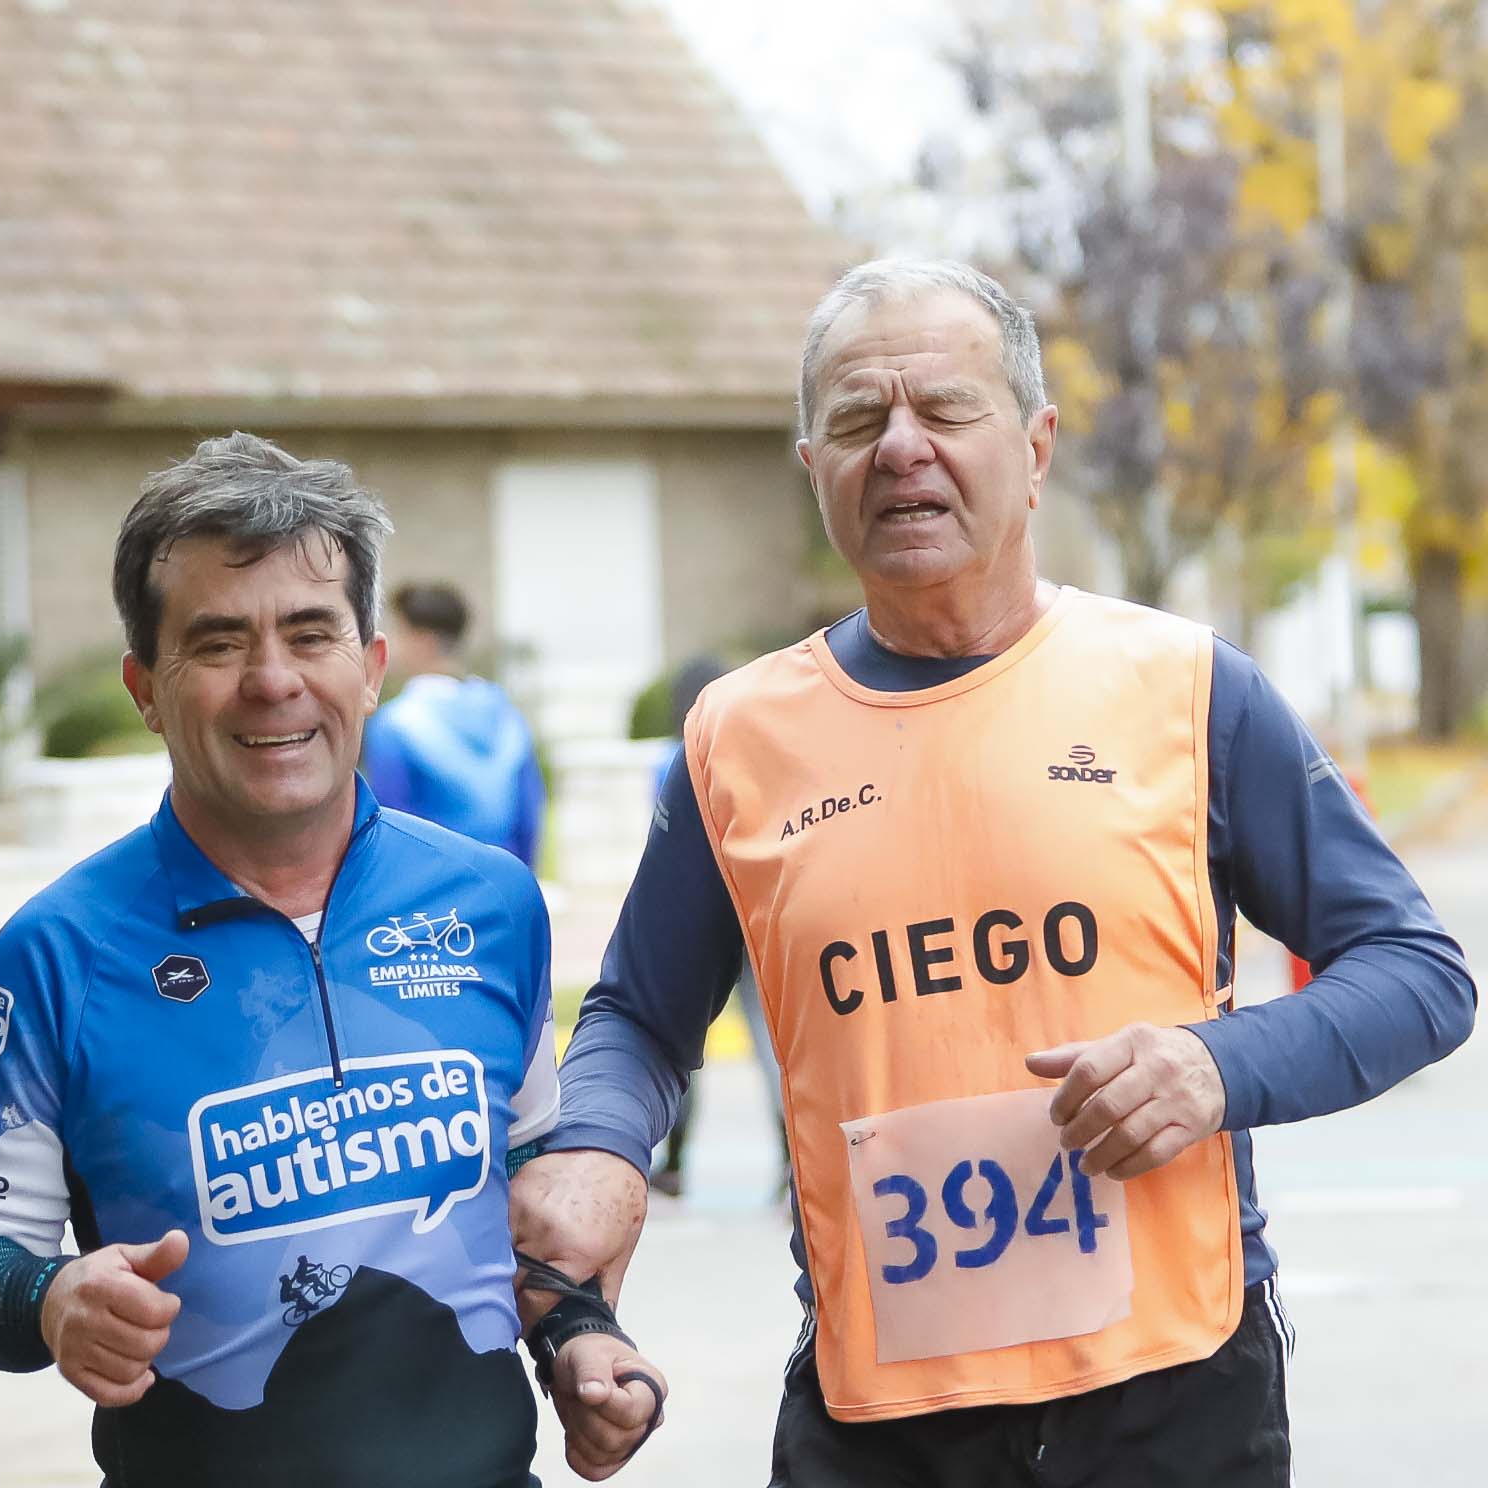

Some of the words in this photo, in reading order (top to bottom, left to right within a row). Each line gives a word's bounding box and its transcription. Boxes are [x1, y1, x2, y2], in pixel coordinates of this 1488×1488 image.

[368, 963, 480, 981] EMPUJANDO
[819, 901, 1098, 1015] CIEGO
[207, 1108, 487, 1221] autismo
[210, 1083, 413, 1161] hablemos
[420, 1059, 469, 1101] de
[872, 1148, 1110, 1285] 394
